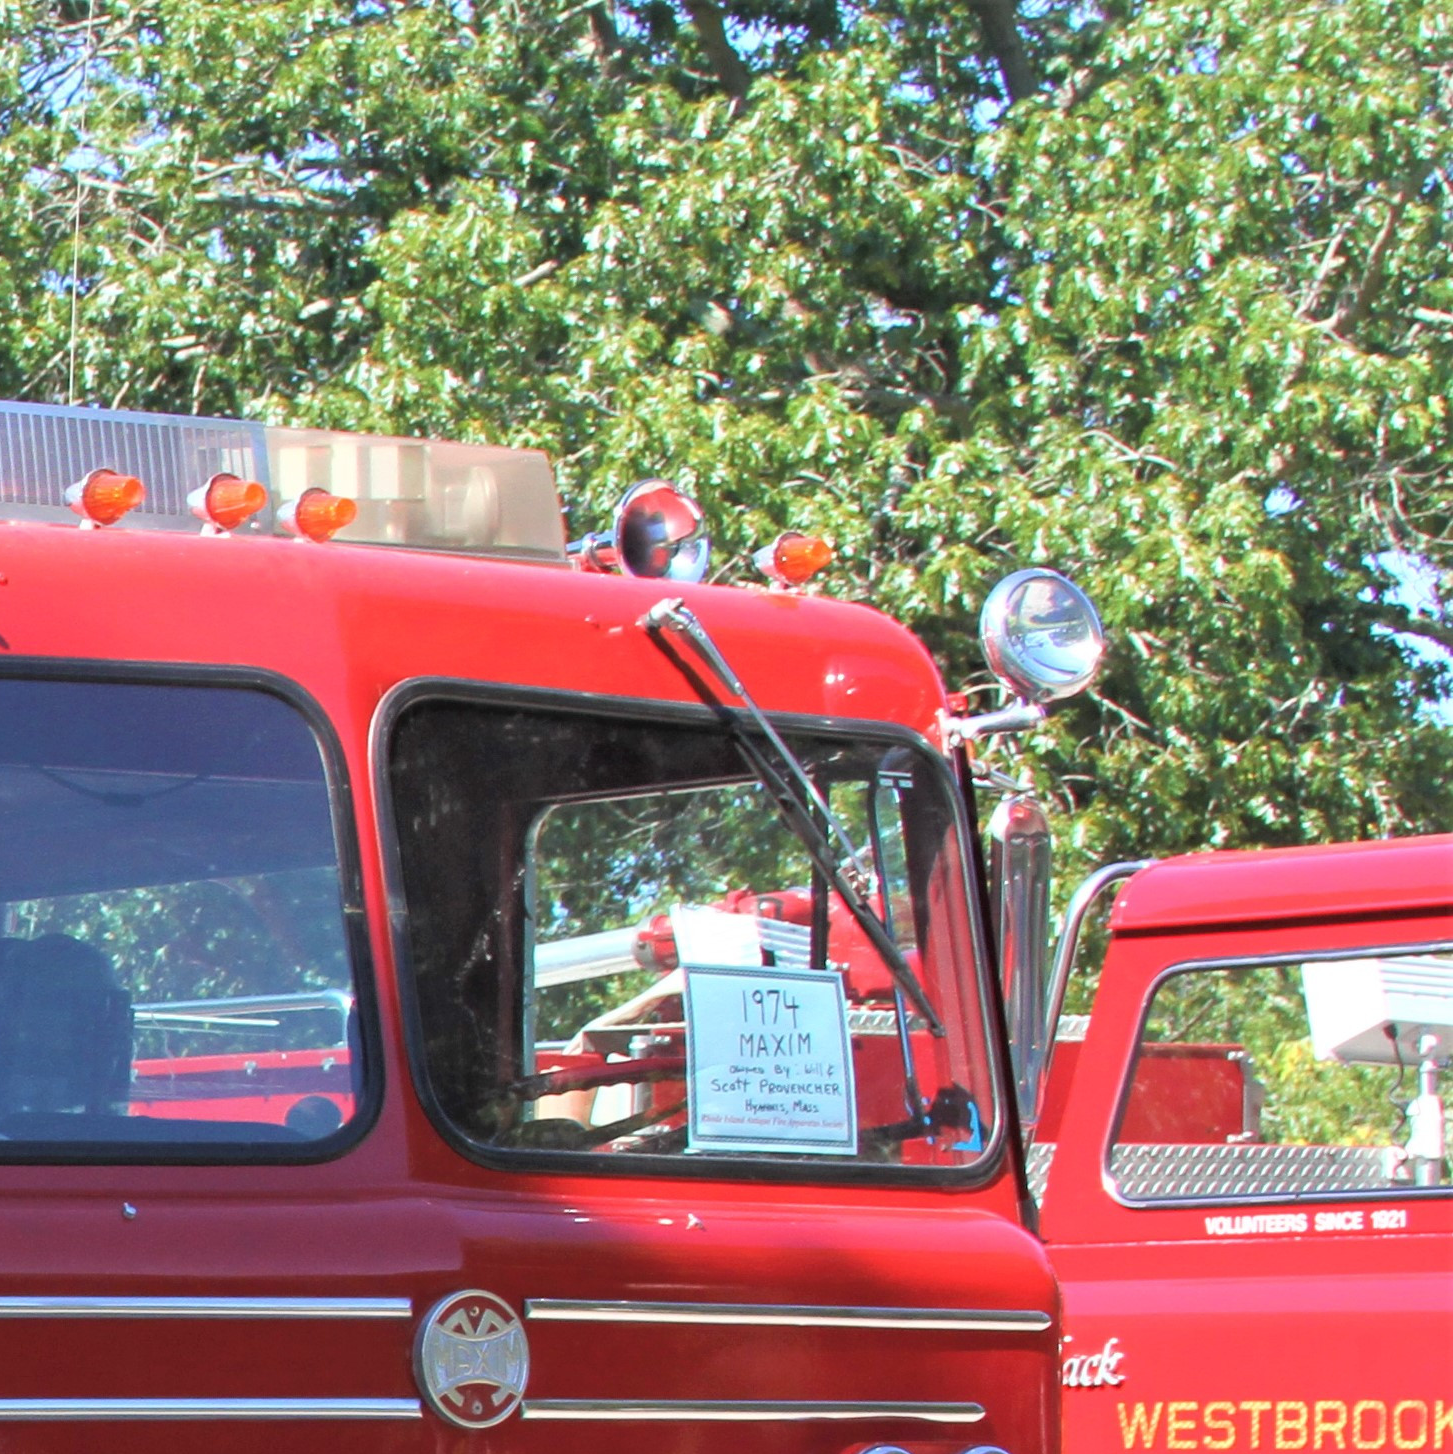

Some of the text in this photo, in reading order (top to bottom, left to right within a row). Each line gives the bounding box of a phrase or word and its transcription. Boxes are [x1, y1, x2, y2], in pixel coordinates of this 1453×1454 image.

[742, 990, 799, 1029] 1974
[740, 1032, 811, 1058] MAXIM
[711, 1078, 751, 1093] Scott
[1204, 1210, 1407, 1235] VOLUNTEERS SINCE 1921
[1062, 1335, 1126, 1388] ack
[1117, 1400, 1453, 1450] WESTBROOK
